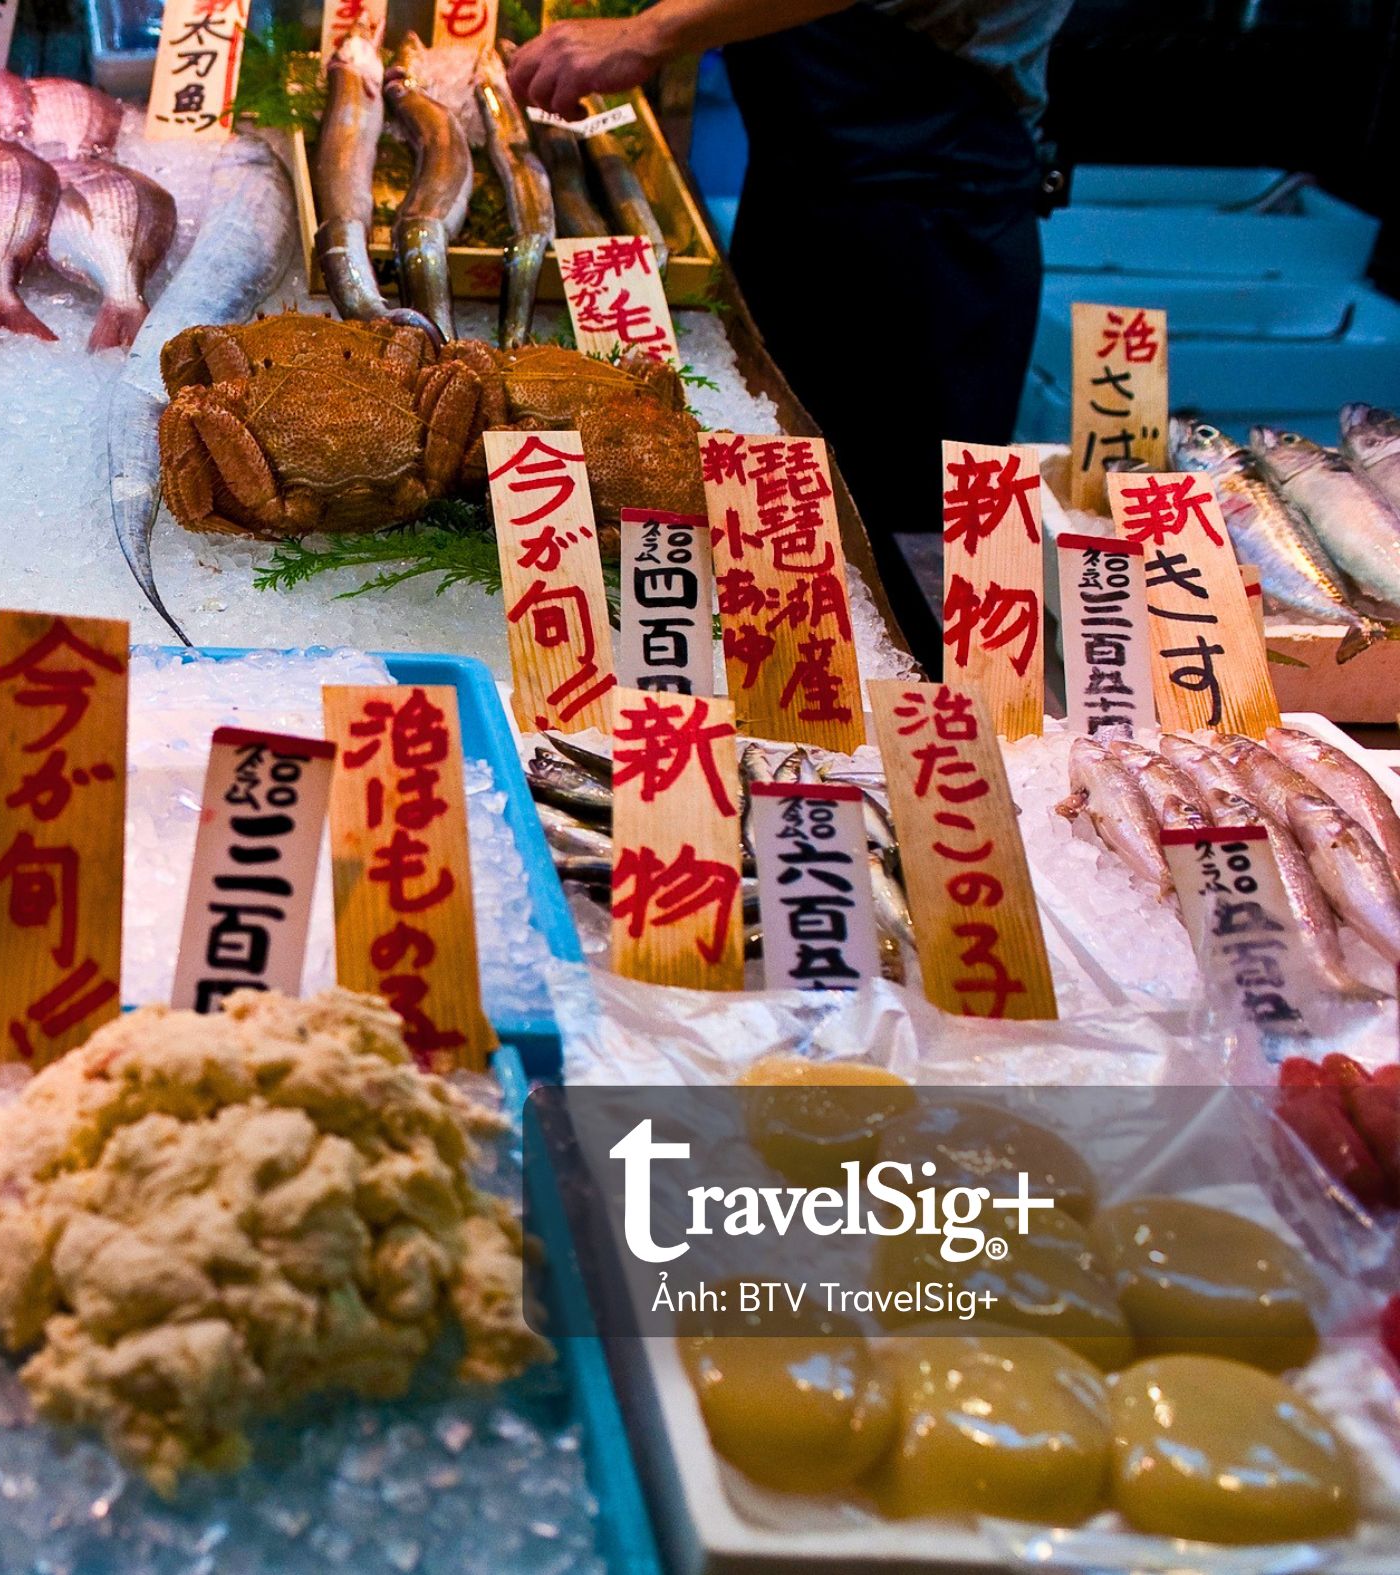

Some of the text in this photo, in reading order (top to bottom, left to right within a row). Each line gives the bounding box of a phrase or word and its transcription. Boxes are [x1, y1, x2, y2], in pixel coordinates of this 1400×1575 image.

[156, 14, 235, 132] 太刀魚
[1082, 311, 1159, 471] 活さば
[747, 441, 852, 723] 琵琶湖産
[943, 450, 1041, 677] 新物
[1121, 475, 1225, 727] 新きす
[612, 695, 742, 965] 新物
